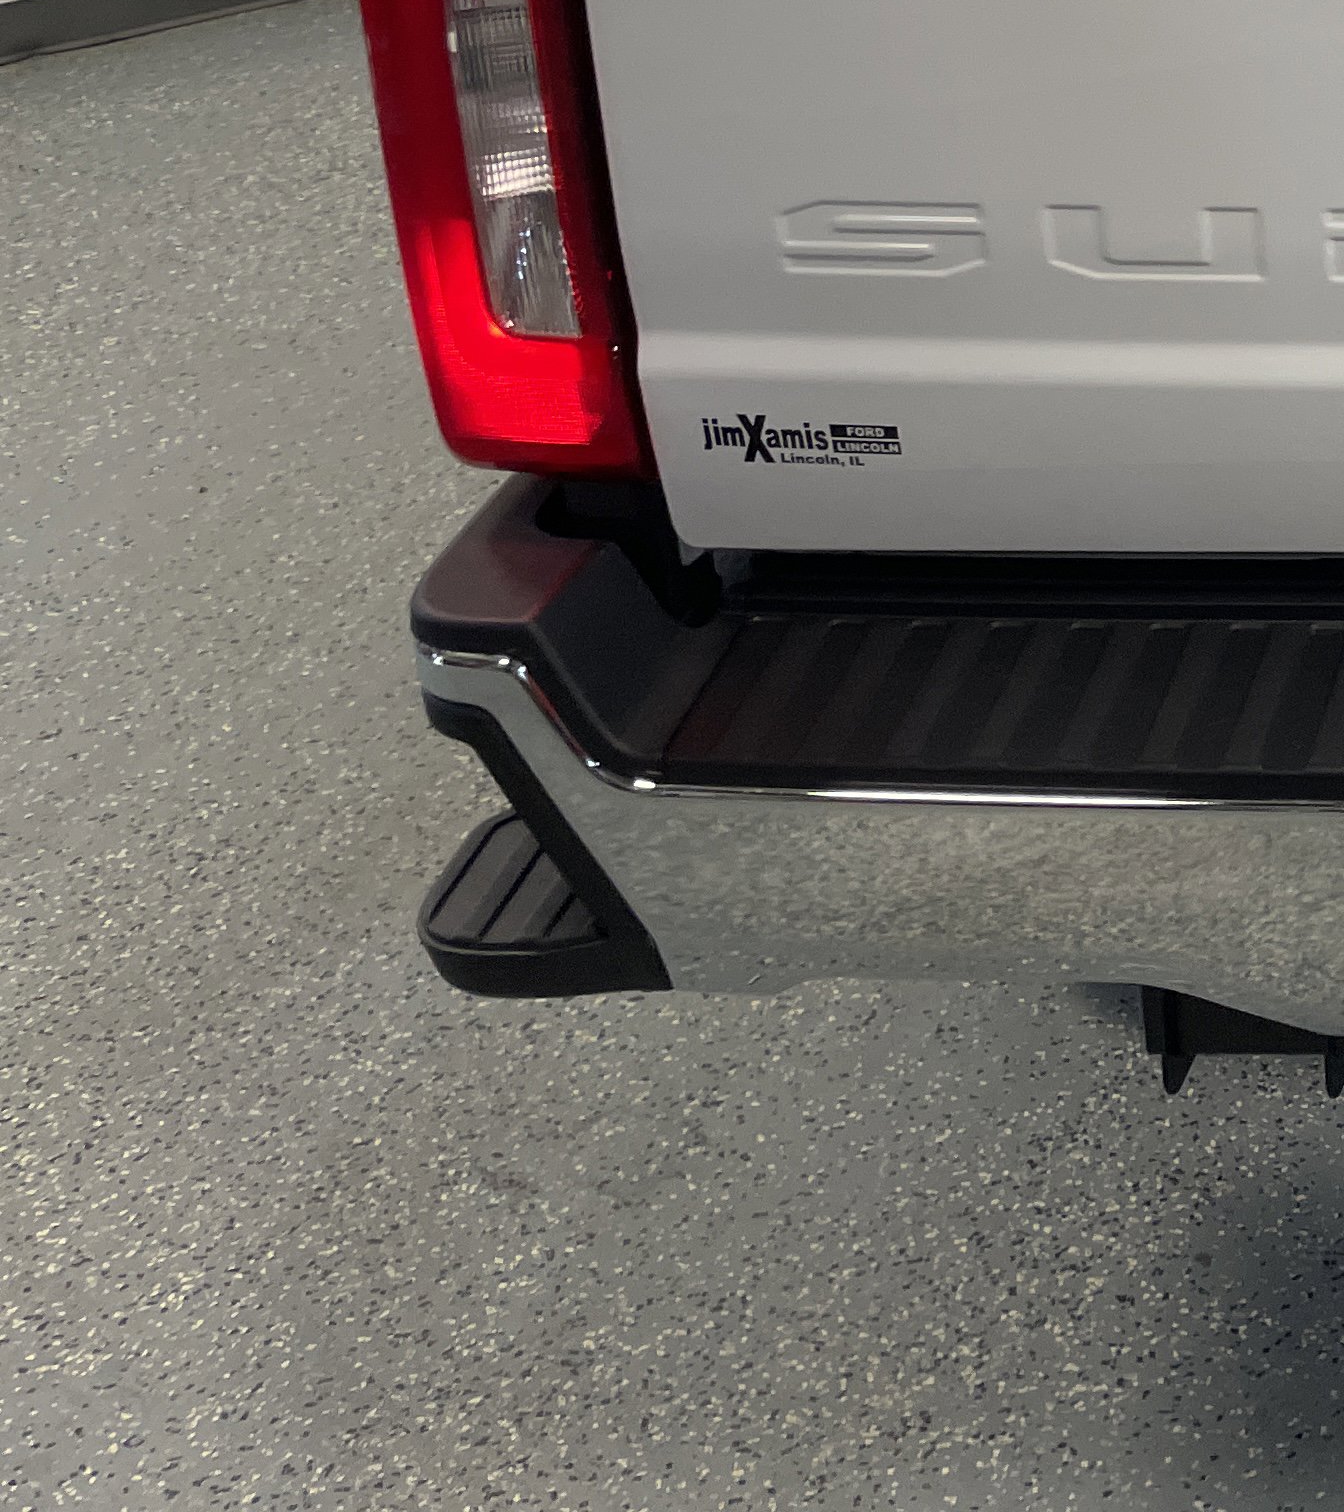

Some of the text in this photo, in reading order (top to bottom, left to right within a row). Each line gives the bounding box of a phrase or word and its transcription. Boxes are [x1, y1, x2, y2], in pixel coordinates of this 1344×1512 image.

[846, 426, 885, 437] FORD
[836, 441, 900, 453] LINCOLN
[781, 453, 865, 467] Lincoln, IL
